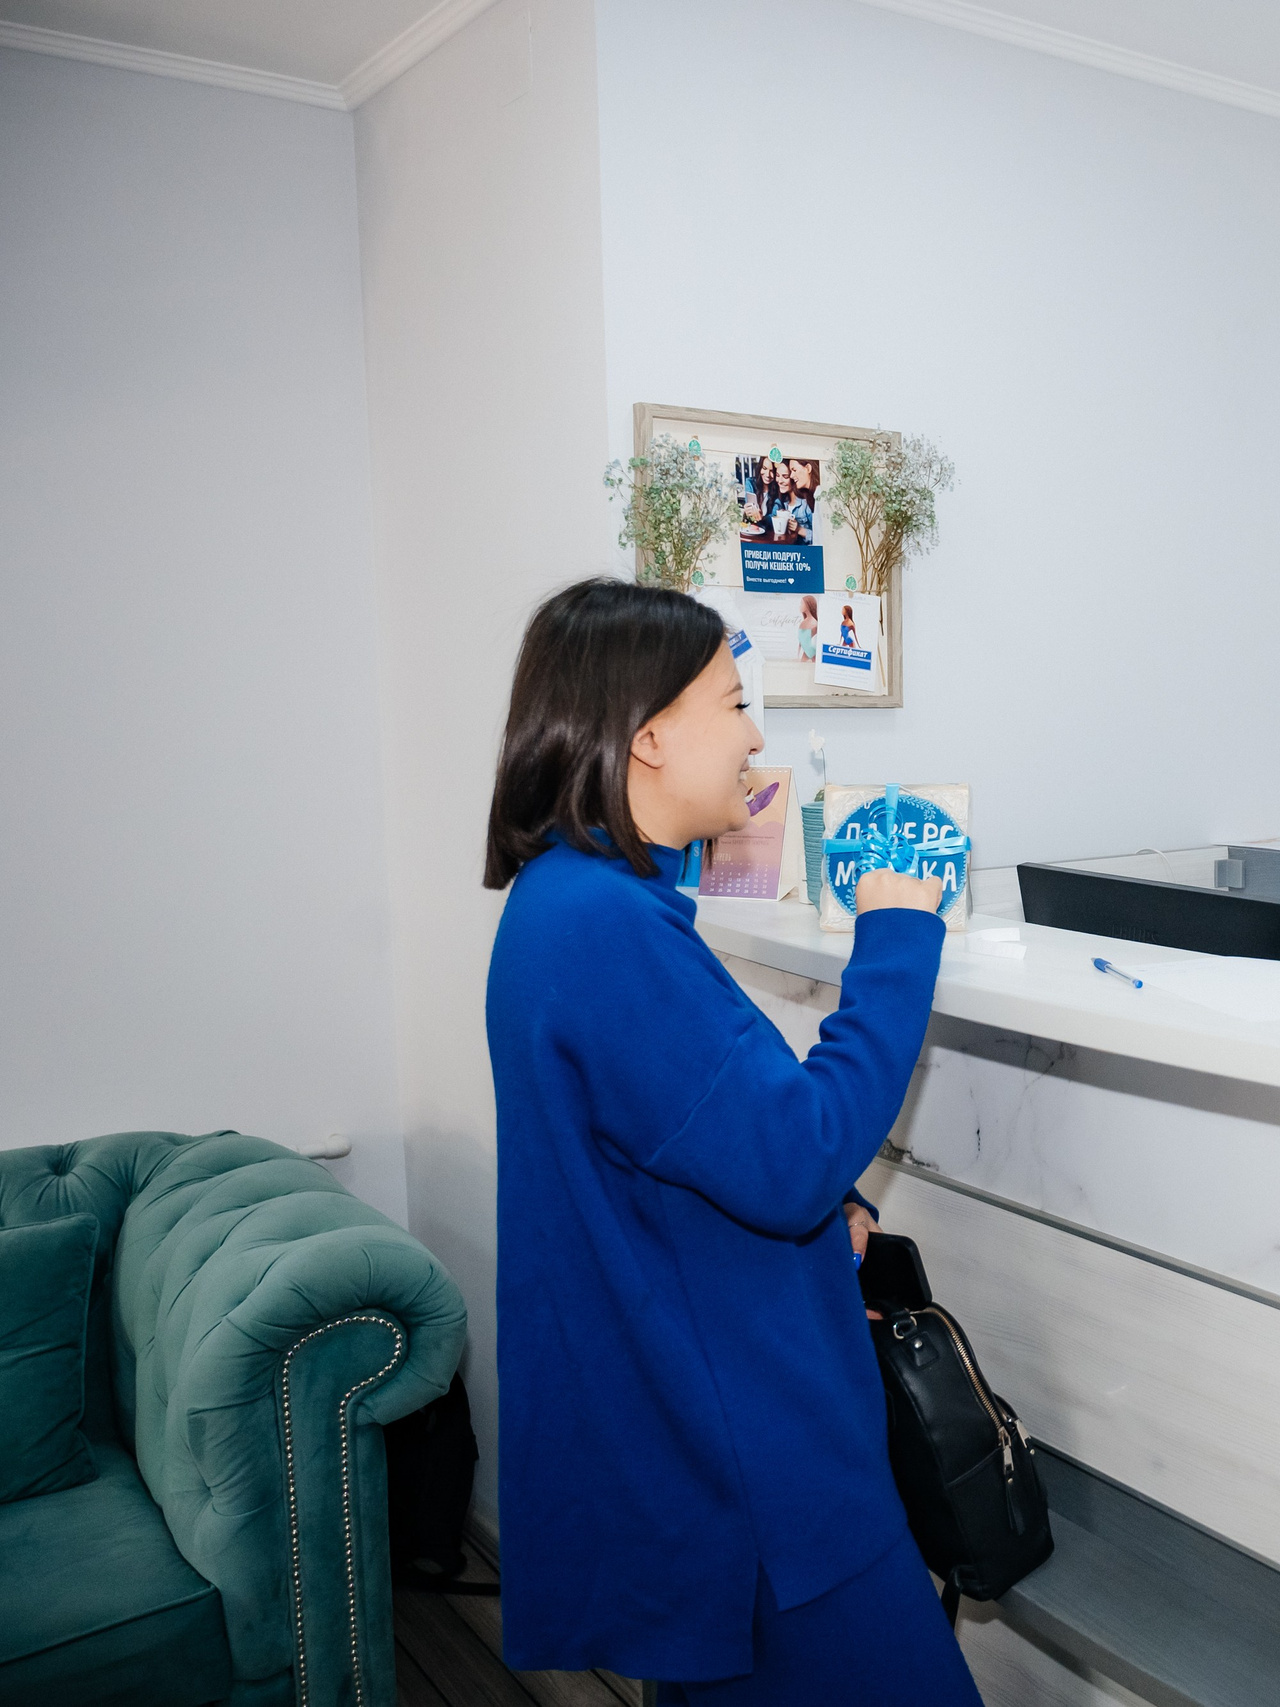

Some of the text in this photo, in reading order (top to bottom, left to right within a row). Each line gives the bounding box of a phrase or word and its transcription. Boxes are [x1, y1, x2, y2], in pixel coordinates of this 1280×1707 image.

[744, 549, 772, 561] ПРИВЕДИ
[772, 551, 801, 562] ПОДРУГУ
[745, 560, 811, 572] ПОЛУЧИ КЕШБЕК 10%
[828, 645, 869, 658] Сертификат
[846, 821, 955, 844] ЛАЕРС
